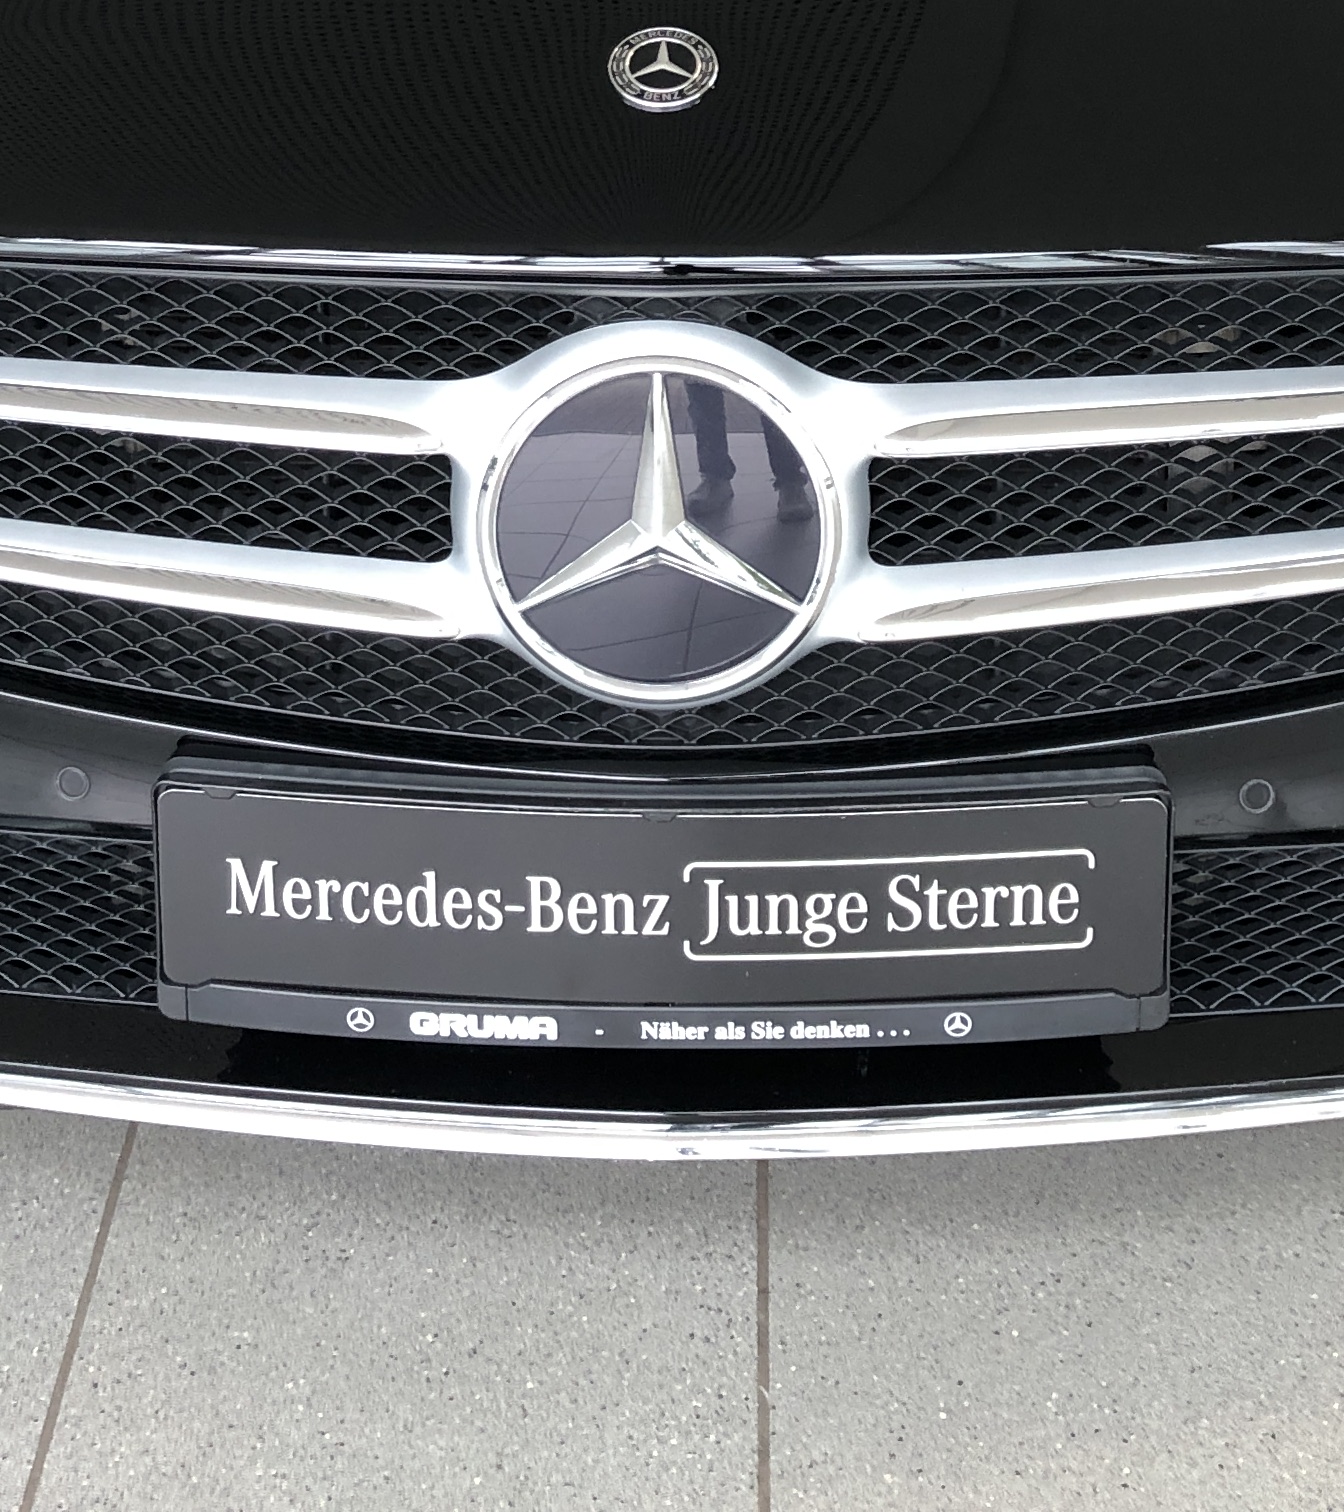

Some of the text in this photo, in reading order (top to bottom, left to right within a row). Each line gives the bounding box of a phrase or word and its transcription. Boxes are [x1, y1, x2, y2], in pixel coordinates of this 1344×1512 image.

[629, 31, 699, 45] MERCEDES
[643, 91, 682, 102] BENZ
[225, 857, 1080, 949] Mercedes-Benz Junge Sterne
[409, 1011, 559, 1041] GRUMA
[640, 1021, 710, 1041] Näher
[714, 1021, 746, 1041] als
[751, 1021, 786, 1040] Sie
[790, 1020, 871, 1040] denken
